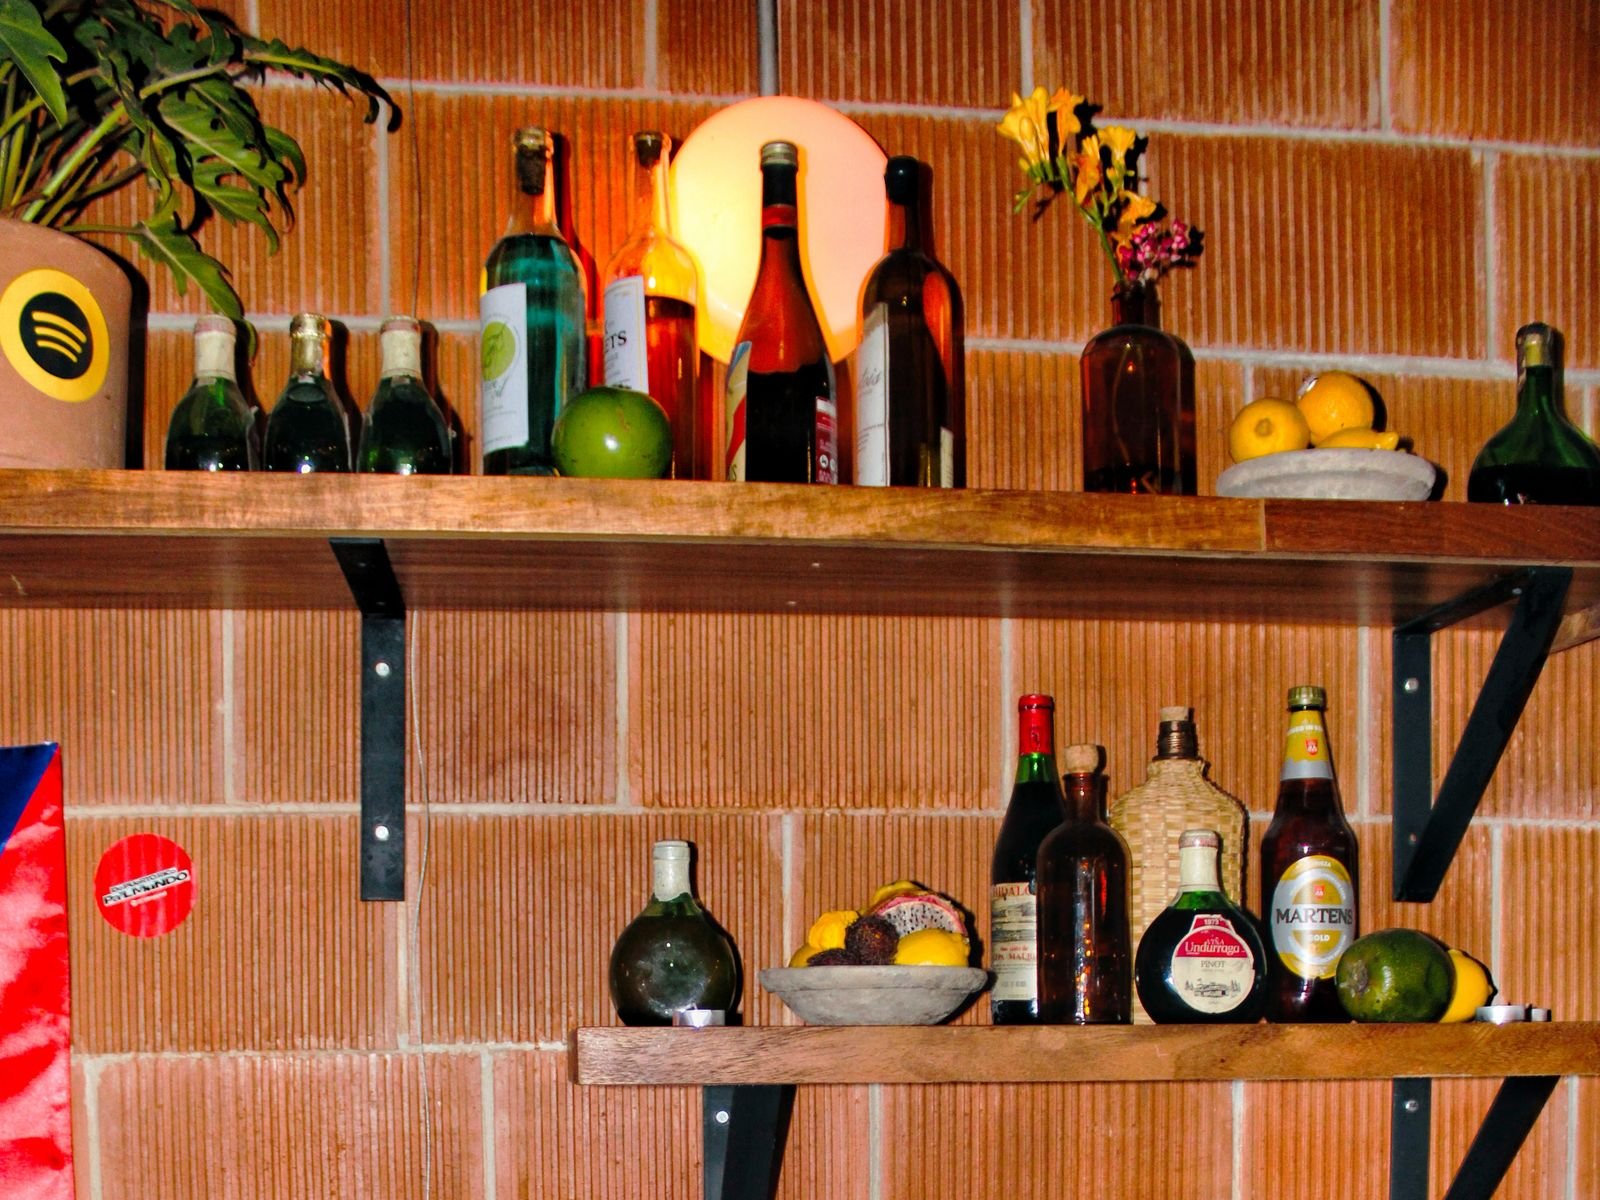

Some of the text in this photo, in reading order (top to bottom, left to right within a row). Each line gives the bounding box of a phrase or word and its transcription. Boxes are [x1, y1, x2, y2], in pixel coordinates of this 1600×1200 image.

[1276, 908, 1353, 924] MARTENS
[1185, 941, 1240, 956] Undurraga
[1200, 960, 1226, 968] PINOT
